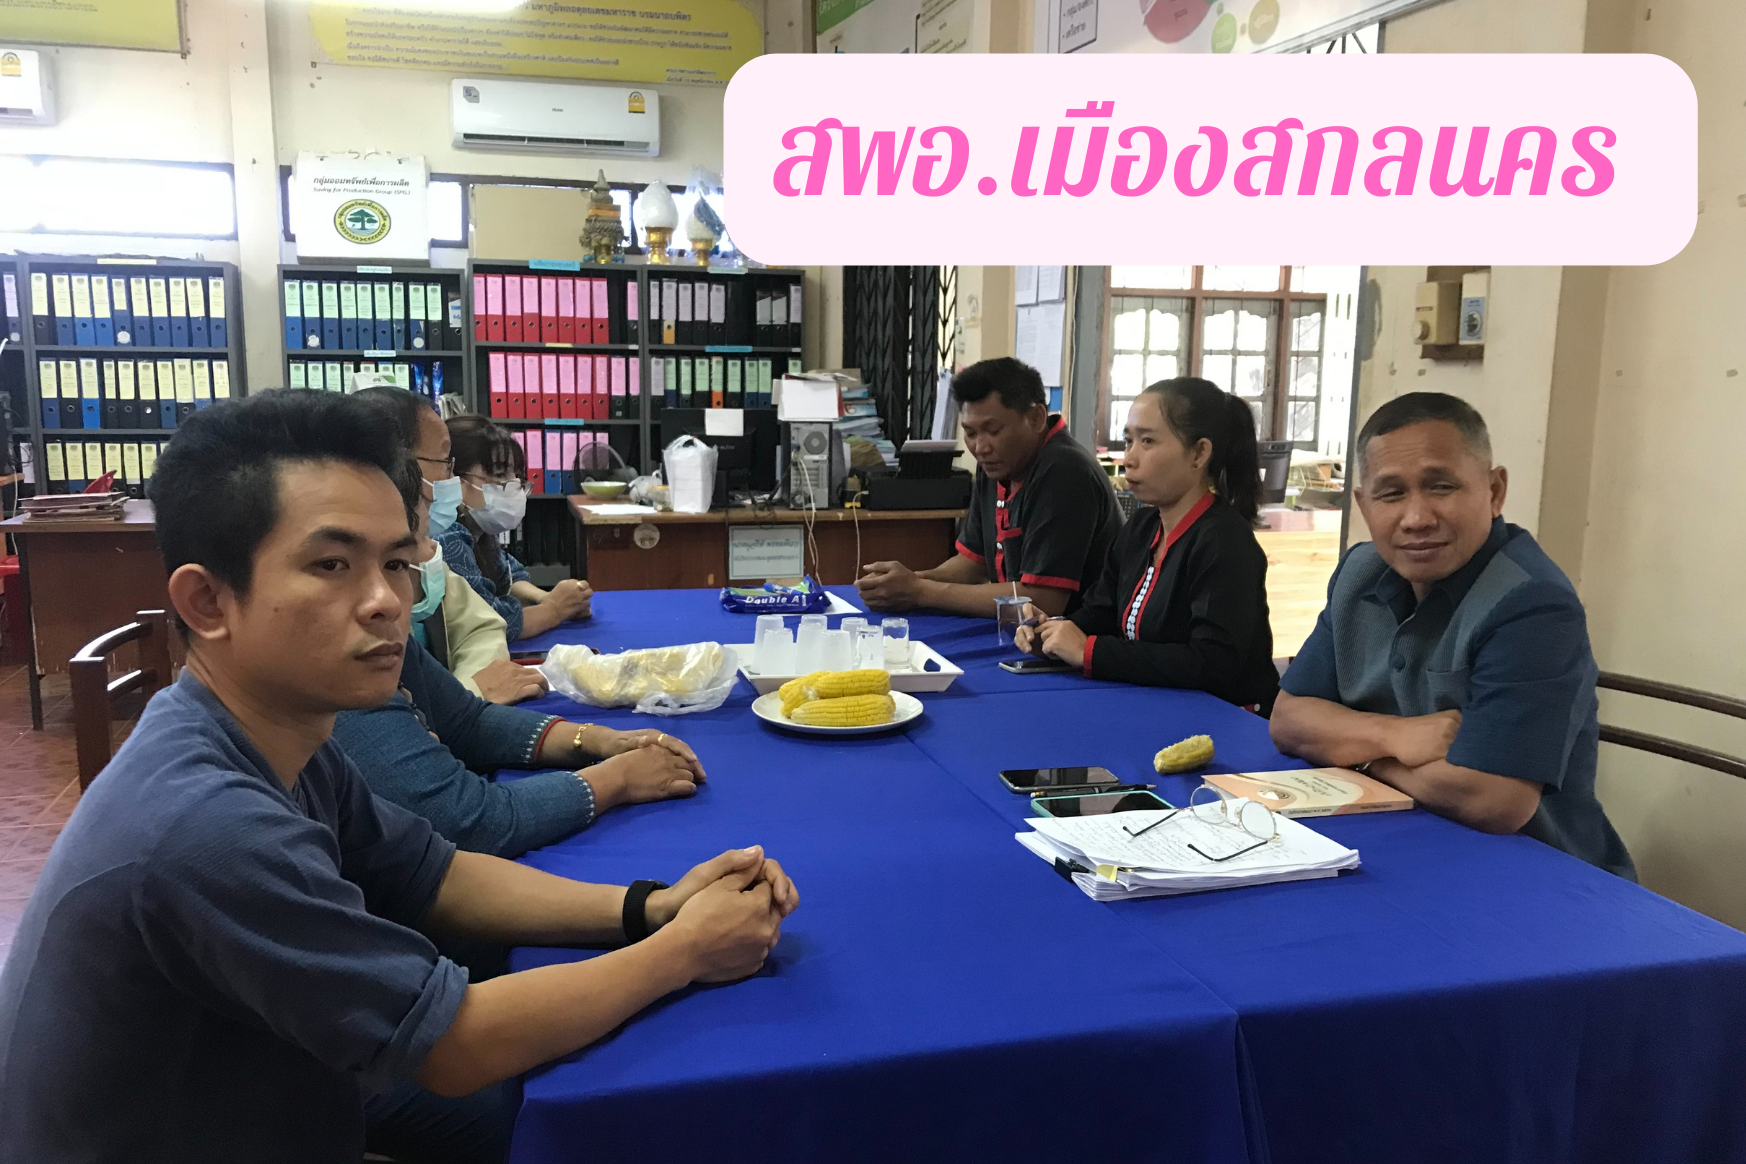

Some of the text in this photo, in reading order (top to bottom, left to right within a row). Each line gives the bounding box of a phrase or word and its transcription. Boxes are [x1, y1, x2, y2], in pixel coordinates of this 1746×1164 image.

[313, 176, 410, 187] กลุ่มออมทรัพย์เพื่อการผลิต
[745, 596, 787, 605] Double
[791, 595, 800, 603] A
